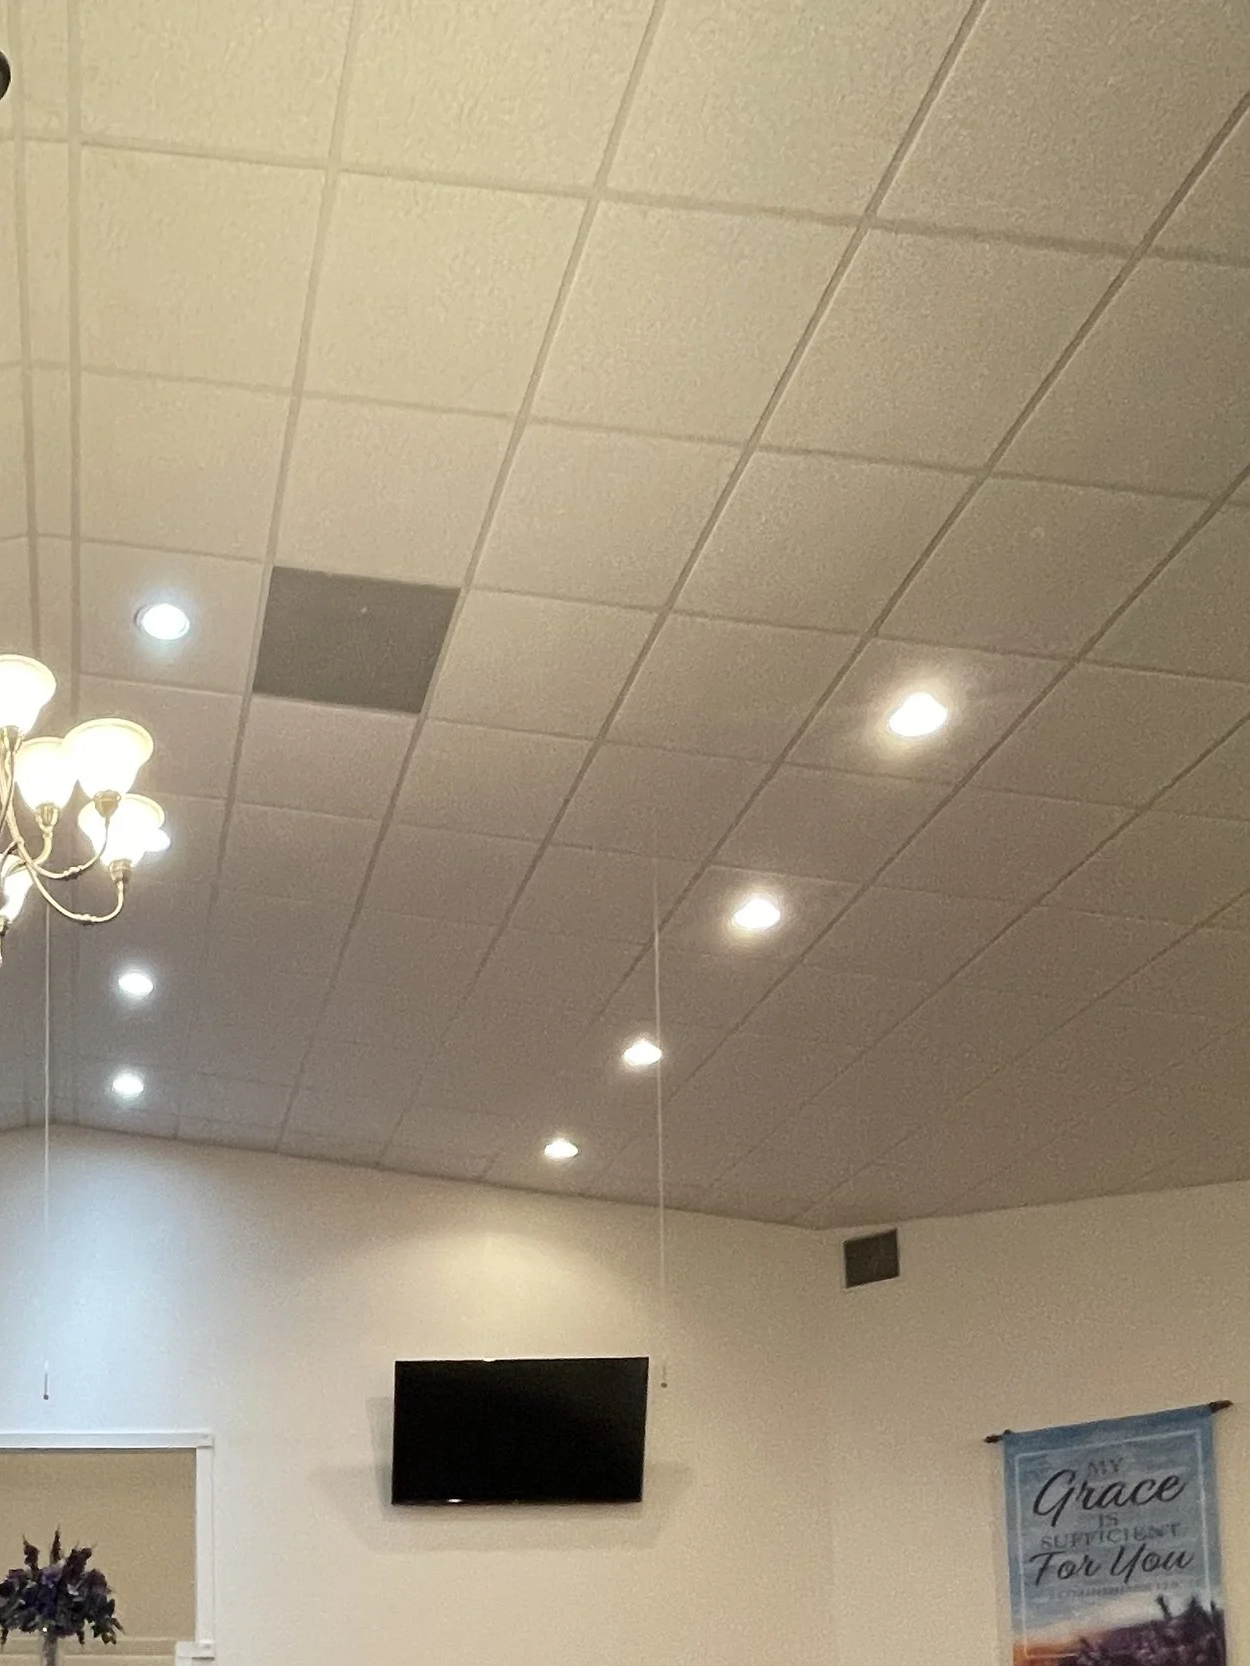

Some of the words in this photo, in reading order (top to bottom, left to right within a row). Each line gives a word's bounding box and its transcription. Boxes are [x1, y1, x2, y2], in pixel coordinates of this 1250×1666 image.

[1087, 1457, 1123, 1475] MY
[1033, 1468, 1186, 1527] Grace
[1098, 1513, 1119, 1528] IS
[1040, 1523, 1181, 1550] SUFFICIENT
[1029, 1550, 1102, 1586] For
[1110, 1542, 1193, 1584] You
